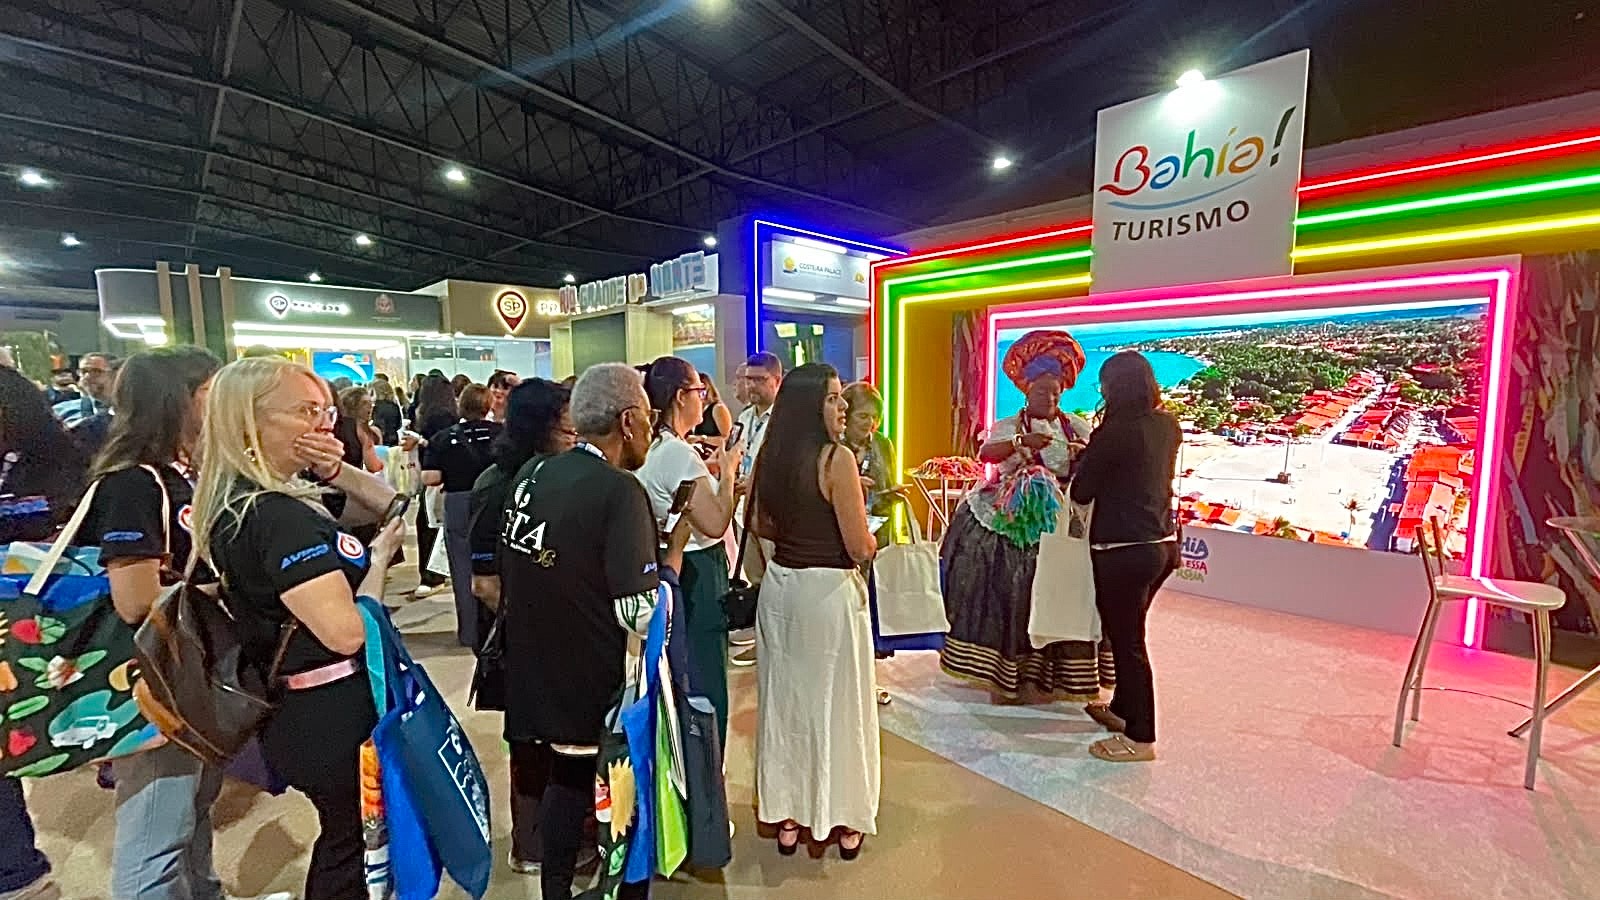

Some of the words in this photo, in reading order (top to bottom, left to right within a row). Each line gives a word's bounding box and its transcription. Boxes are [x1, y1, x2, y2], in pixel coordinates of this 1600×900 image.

[1112, 199, 1250, 241] TURISMO
[579, 275, 627, 309] GRANDE
[651, 250, 705, 298] NORTE
[503, 298, 521, 314] SP
